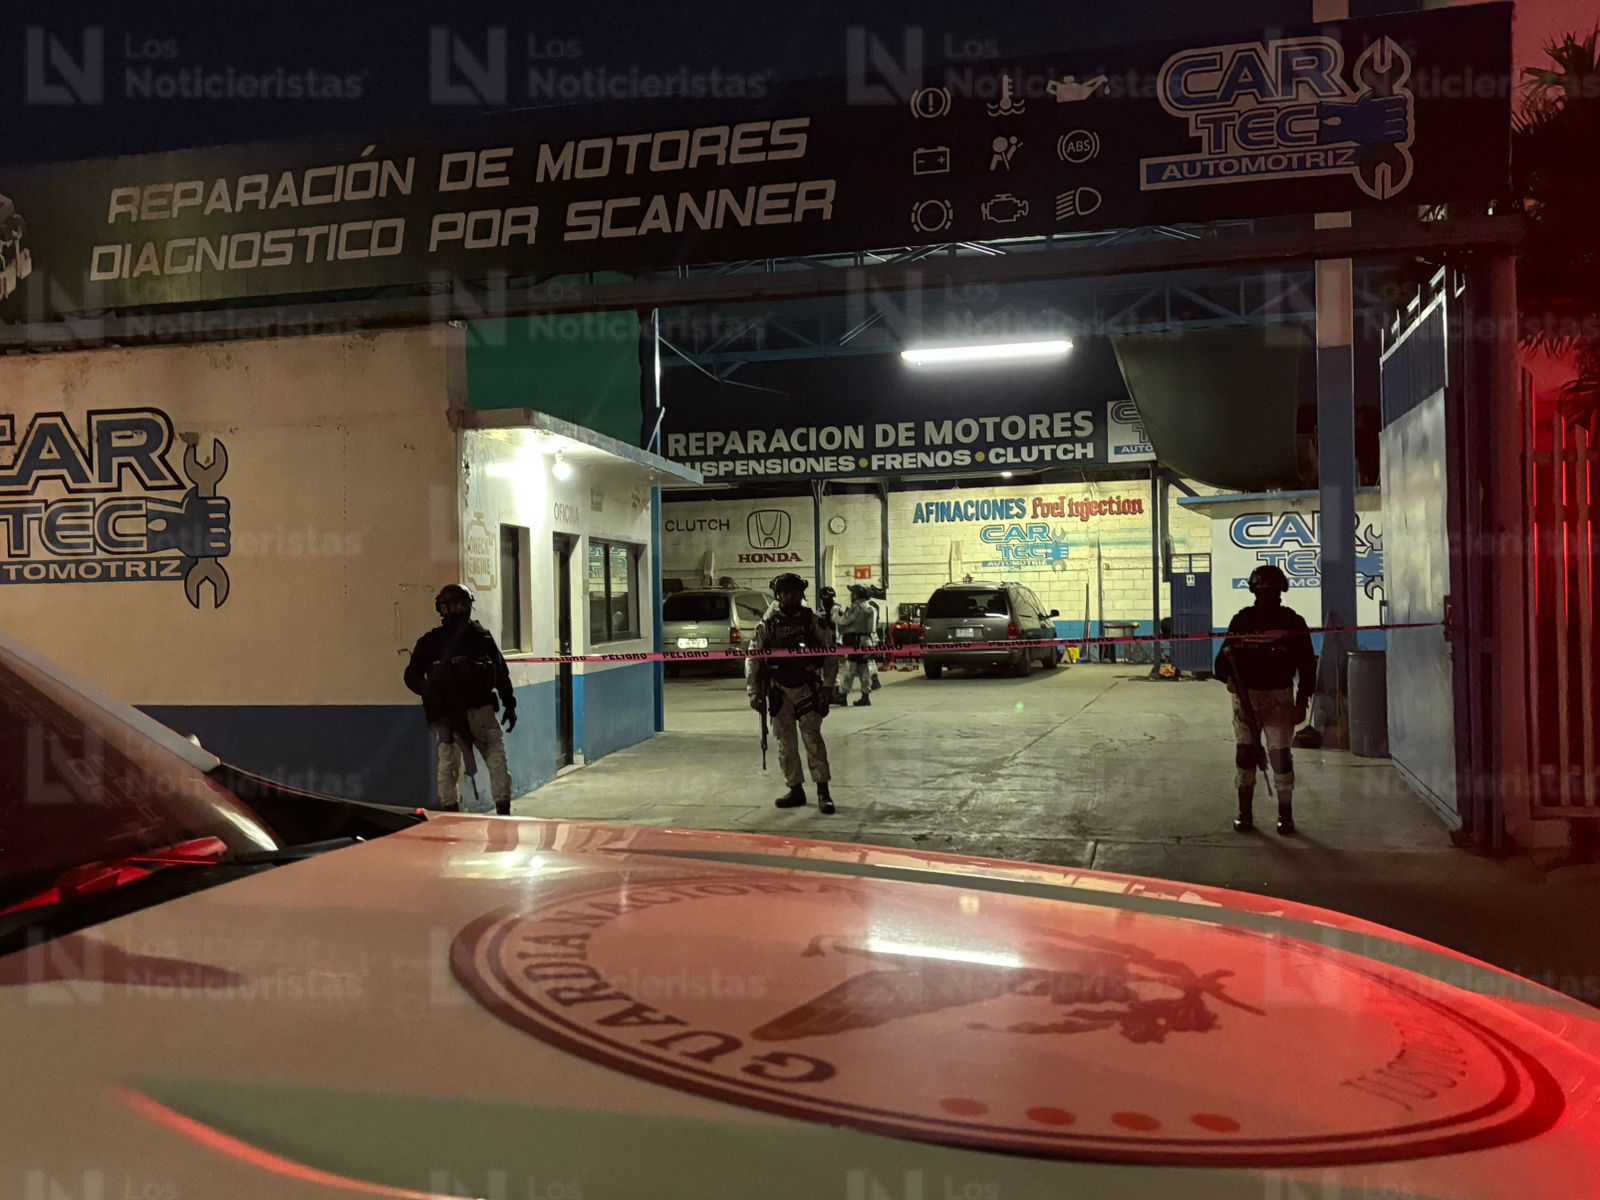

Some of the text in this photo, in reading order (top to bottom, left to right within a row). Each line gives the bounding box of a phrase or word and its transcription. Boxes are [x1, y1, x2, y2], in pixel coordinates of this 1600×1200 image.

[1161, 40, 1350, 107] CAR
[1196, 104, 1321, 153] TEC
[1067, 139, 1091, 154] ABS
[108, 117, 811, 224] REPARACIÓN DE MOTORES
[1161, 148, 1356, 181] AUTOMOTRIZ
[89, 178, 837, 282] DIAGNOSTICO POR SCANNER
[667, 423, 864, 457] REPARACION
[874, 421, 914, 449] DE
[924, 409, 1095, 446] MOTORES
[682, 441, 1095, 477] USPENSIONES FRENOS CLUTCH
[913, 497, 1026, 524] AFINACIONES
[0, 496, 148, 556] TEC
[664, 518, 731, 533] CLUTCH
[980, 523, 1053, 543] CAR
[737, 552, 802, 564] HONDA
[996, 543, 1046, 559] TEC
[1257, 550, 1322, 577] TE
[2, 559, 183, 581] TOMOTRIZ
[662, 650, 709, 659] PELIGRO
